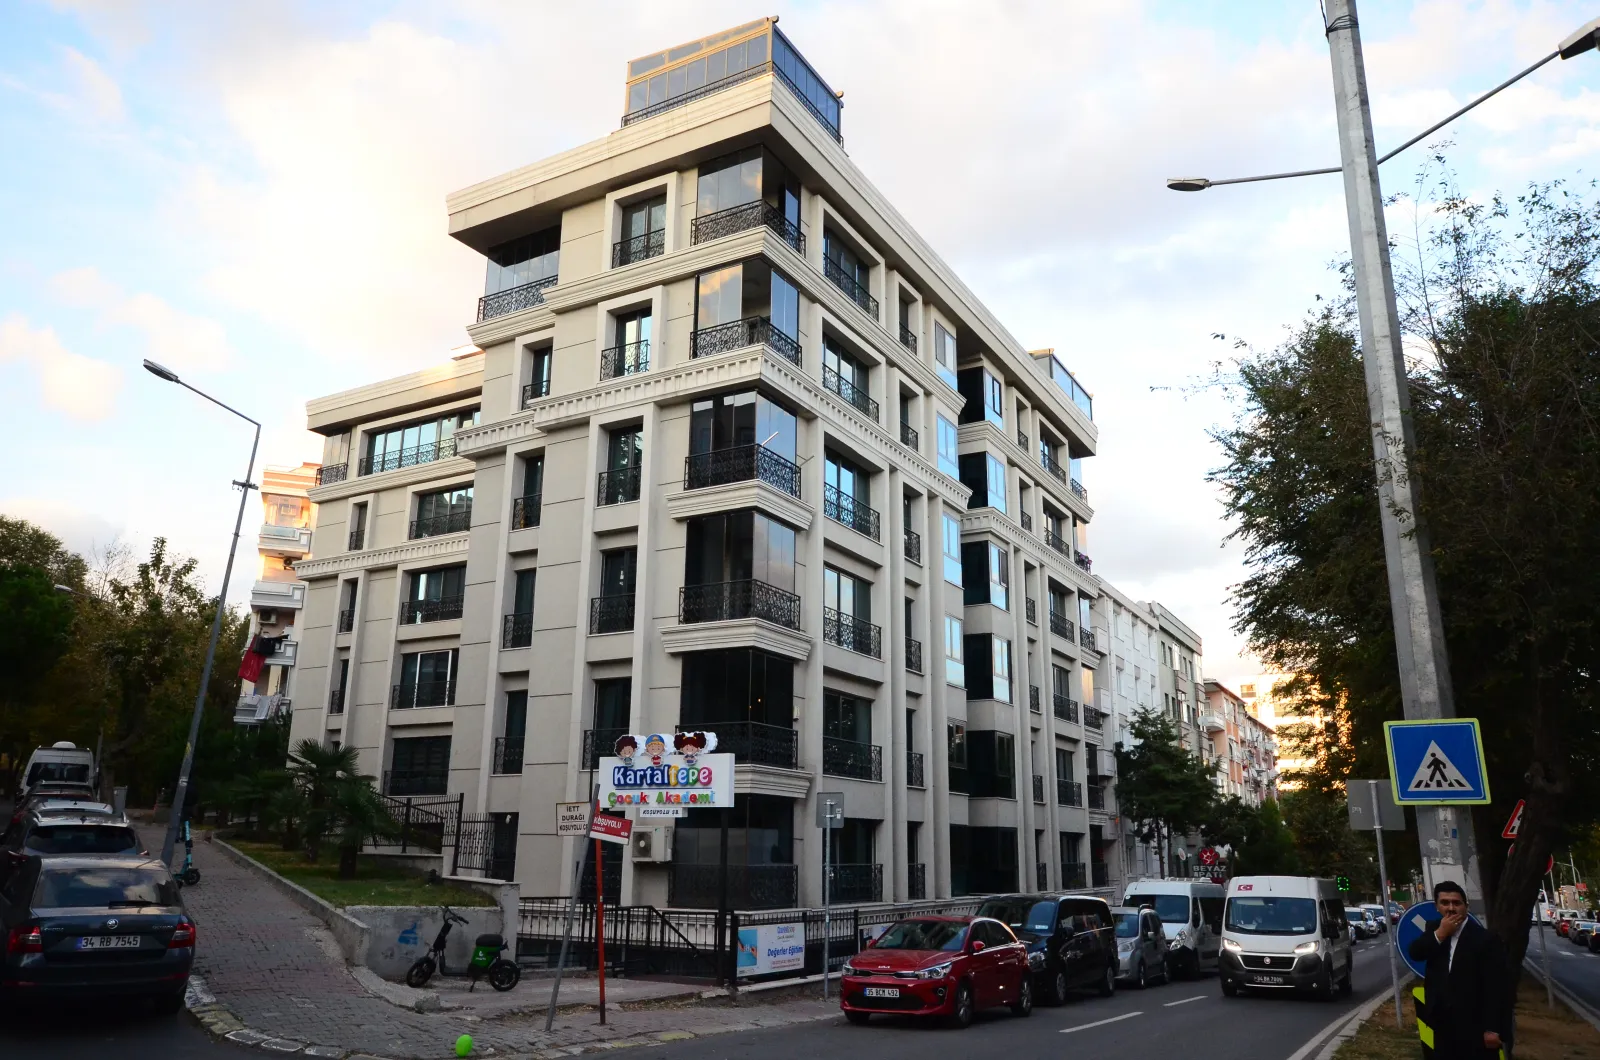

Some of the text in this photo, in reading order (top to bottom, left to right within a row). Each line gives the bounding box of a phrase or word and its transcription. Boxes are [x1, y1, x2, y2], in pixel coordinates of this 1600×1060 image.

[613, 765, 712, 786] Kartaltepe
[608, 791, 715, 806] Çocuk Akademi
[559, 823, 582, 832] KOŞUYOLU
[593, 816, 622, 829] KOŞUYOLU
[82, 936, 139, 948] 34 RB 7545
[767, 947, 788, 958] Değerler
[867, 988, 874, 996] 35
[887, 989, 899, 997] 492
